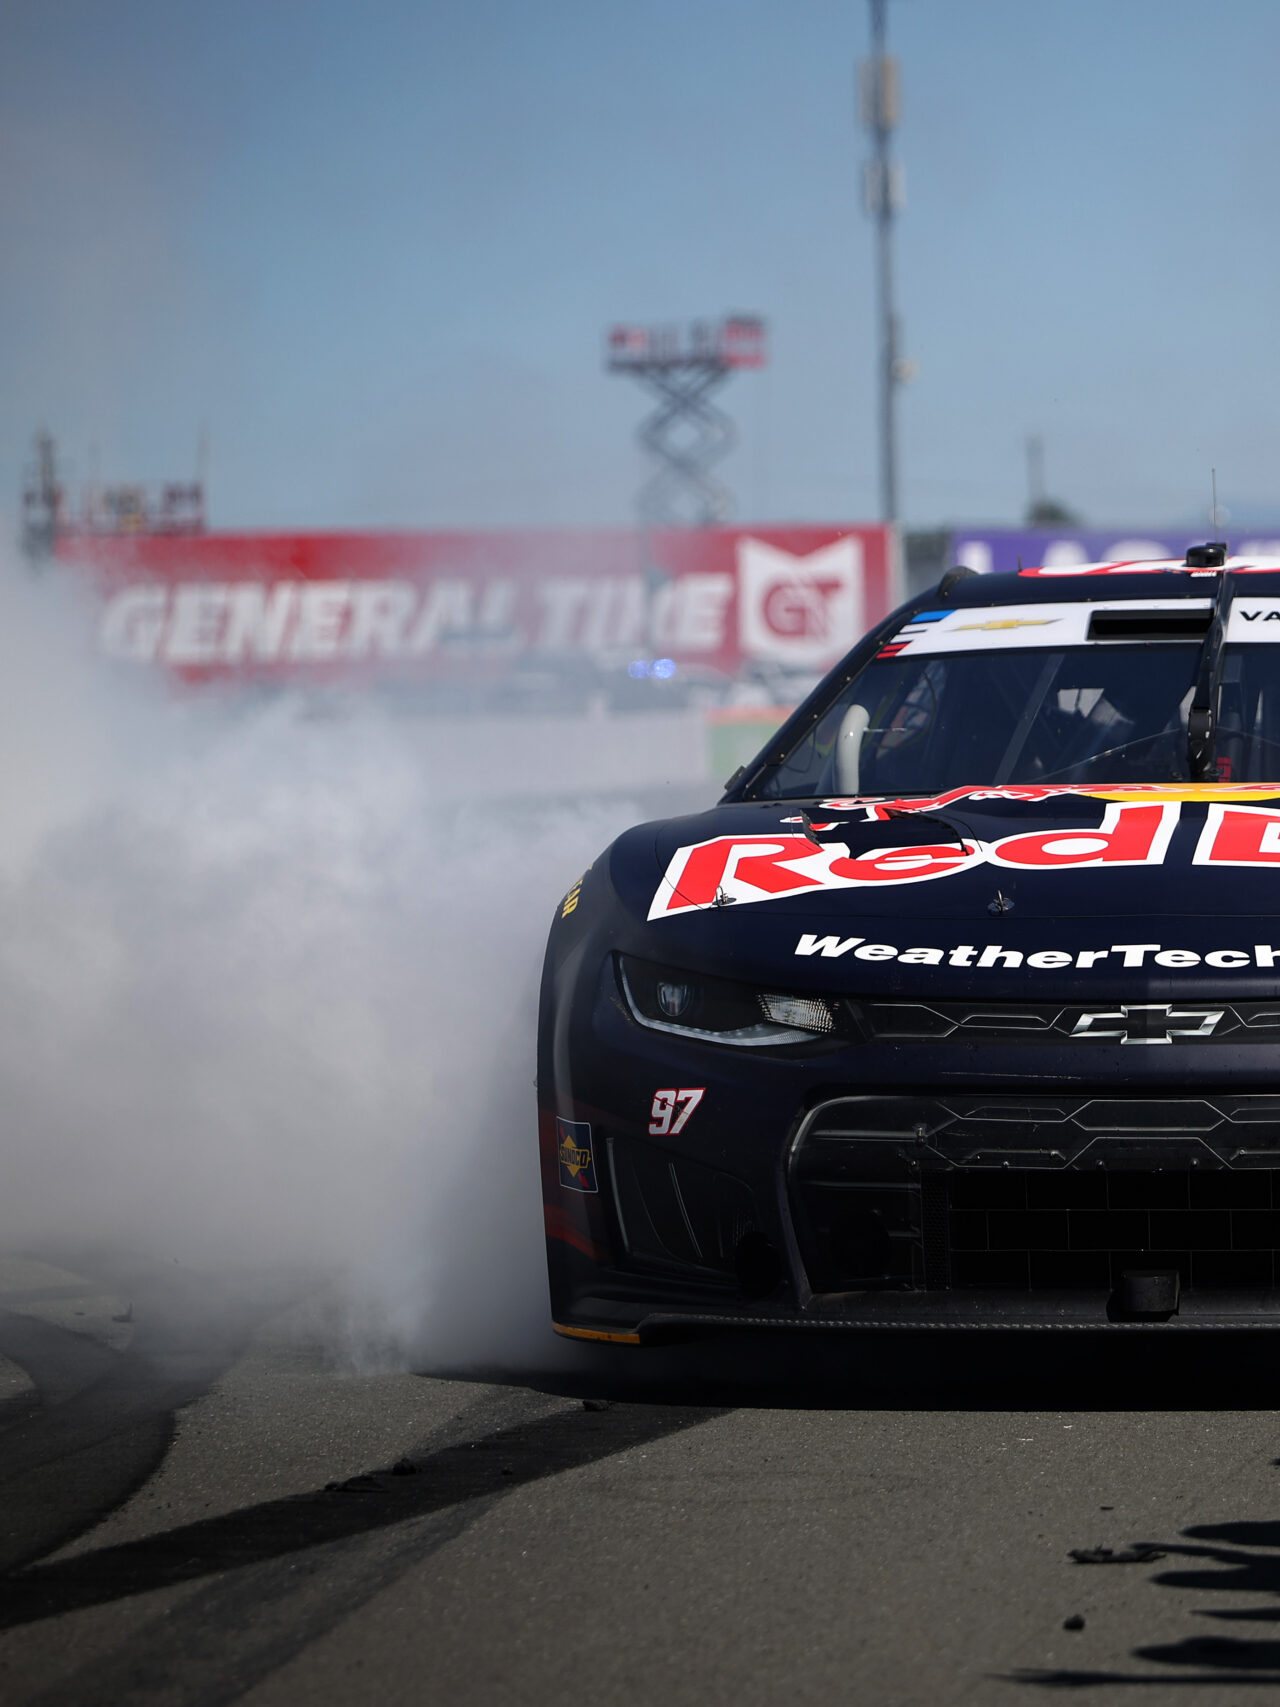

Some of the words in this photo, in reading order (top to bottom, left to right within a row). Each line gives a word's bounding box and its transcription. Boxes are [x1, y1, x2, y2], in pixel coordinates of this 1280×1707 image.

[647, 801, 1181, 921] Red
[648, 1087, 707, 1136] 97
[559, 1146, 589, 1168] SUNOCO
